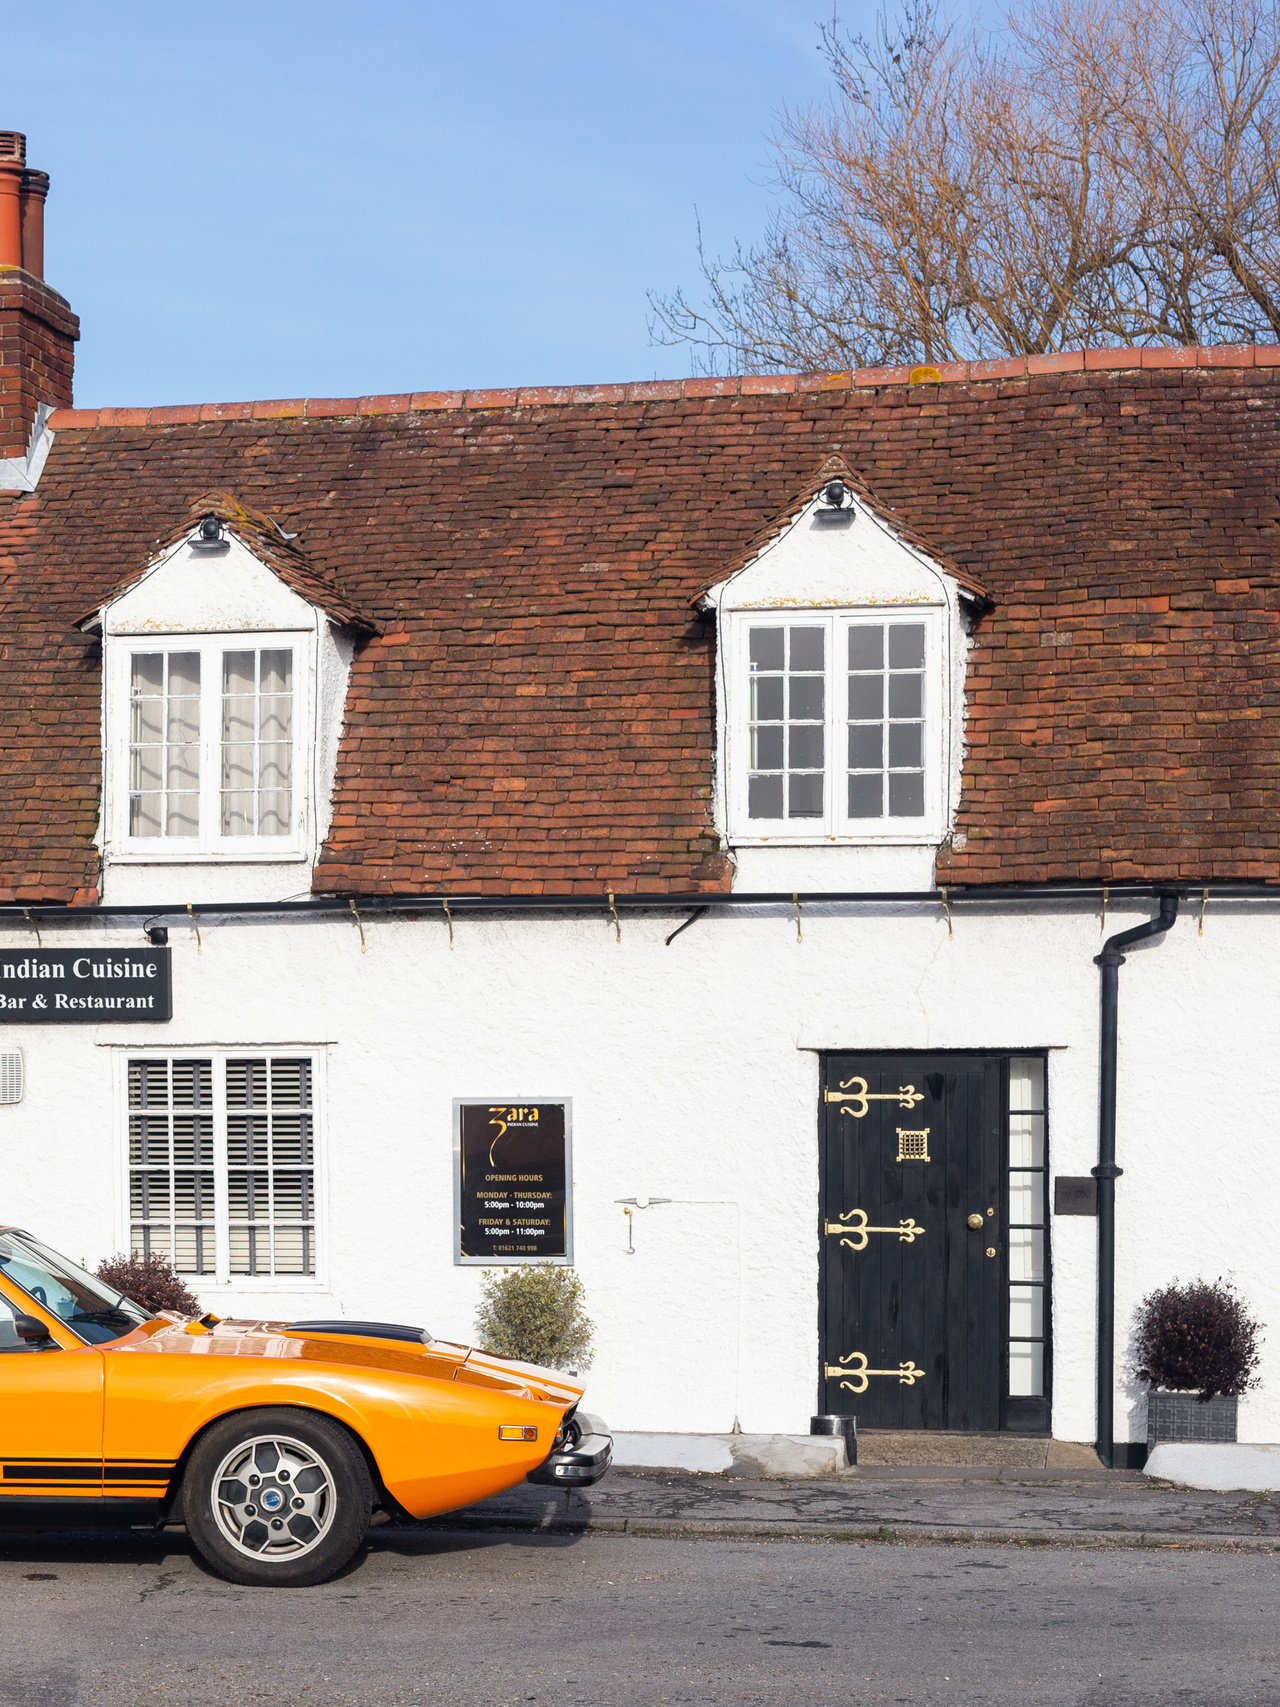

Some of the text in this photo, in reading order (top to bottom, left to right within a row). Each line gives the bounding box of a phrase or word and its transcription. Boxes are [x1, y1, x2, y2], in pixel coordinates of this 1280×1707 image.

[73, 958, 156, 978] Cuisine
[32, 994, 48, 1008] &
[55, 994, 154, 1008] Restaurant
[485, 1201, 509, 1209] 5:00pm
[516, 1201, 544, 1209] 10:00pm
[485, 1228, 509, 1236] 5:00pm
[516, 1228, 544, 1236] 11:00pm
